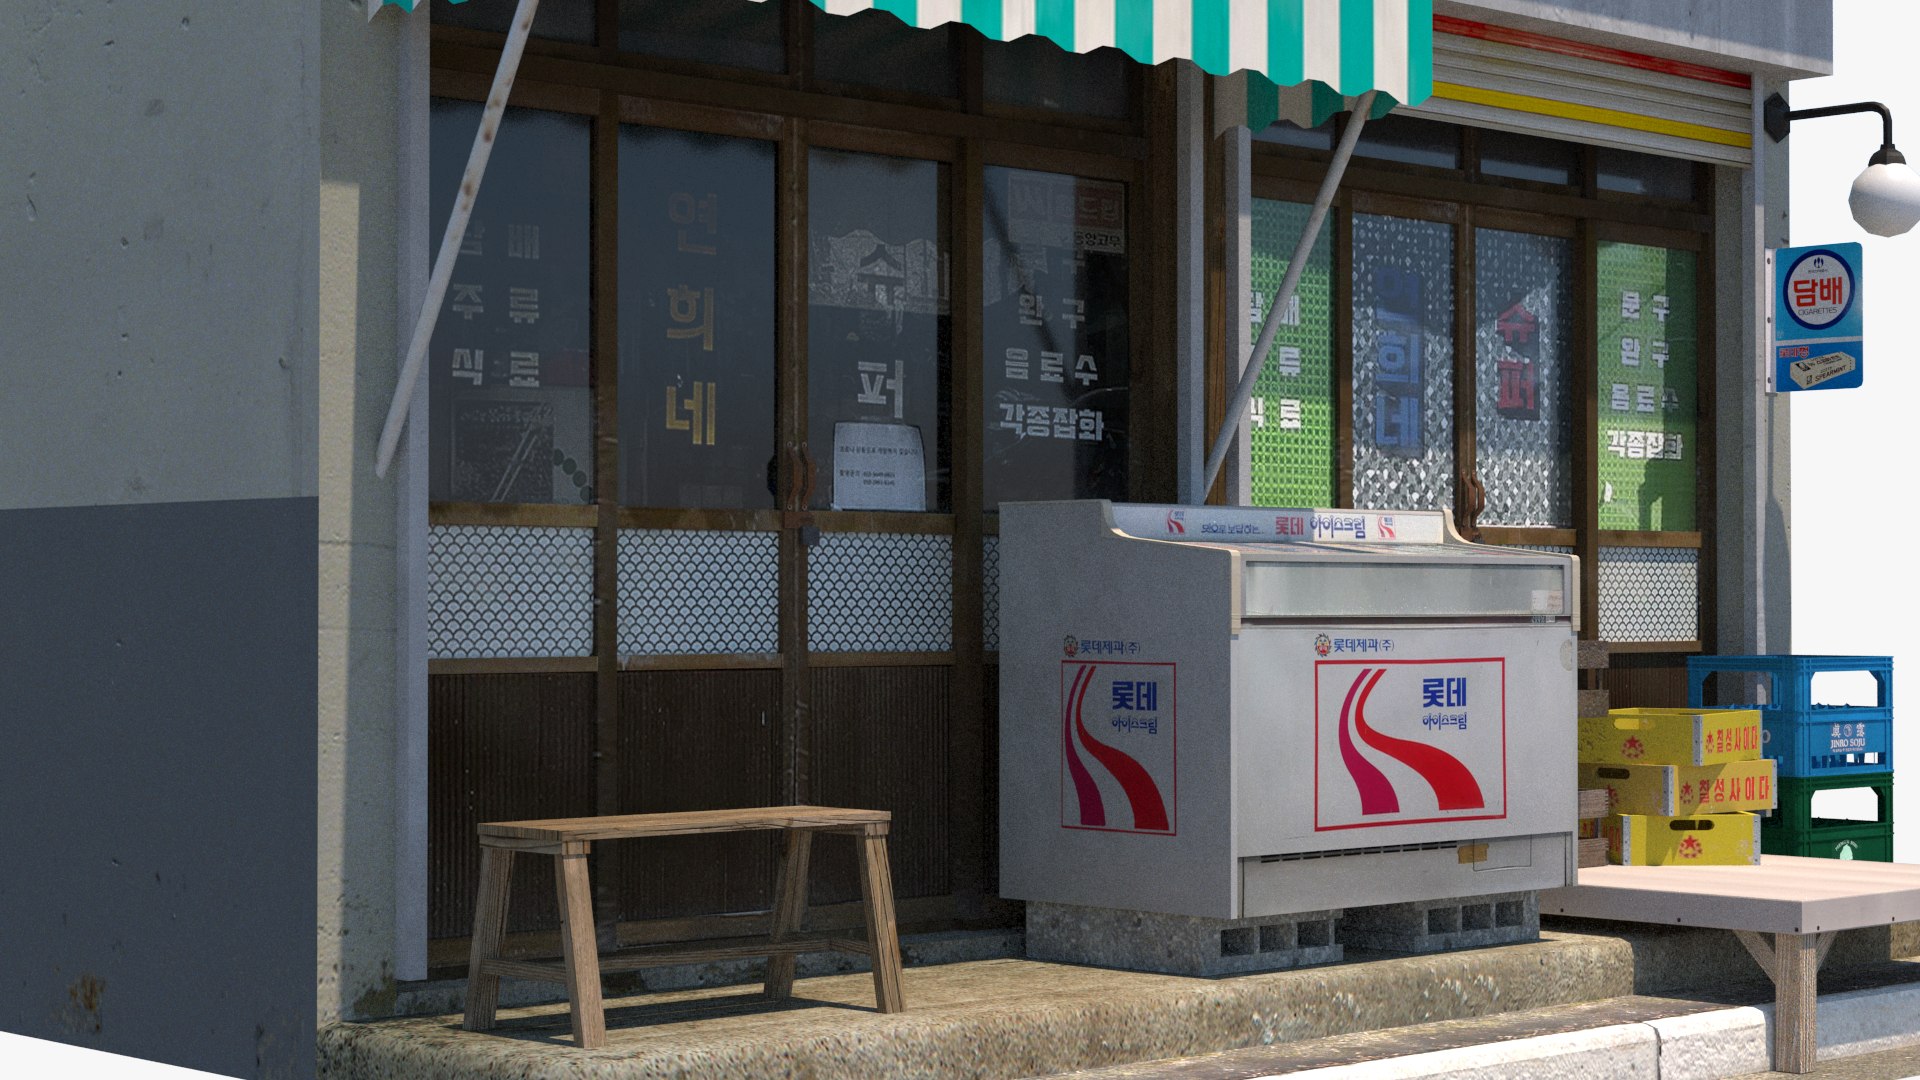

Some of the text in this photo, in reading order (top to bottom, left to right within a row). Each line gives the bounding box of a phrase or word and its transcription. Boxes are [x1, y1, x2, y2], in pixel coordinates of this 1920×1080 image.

[452, 283, 540, 324] 주류
[1793, 276, 1843, 307] 담배
[1797, 306, 1838, 316] CIGARETTES
[1005, 347, 1098, 386] 음료수
[1497, 303, 1536, 410] 슈퍼
[1815, 364, 1847, 383] SPEARMINT
[999, 403, 1105, 442] 각종잡화
[1606, 429, 1684, 460] 각종잡화
[1275, 516, 1304, 536] 롯데
[1310, 515, 1366, 539] 아이스크림
[1080, 639, 1140, 655] 롯데제과(주)
[1333, 638, 1395, 653] 롯데제과(주)
[1112, 680, 1157, 711] 롯데
[1422, 677, 1467, 708] 롯데
[1112, 716, 1158, 735] 아이스크림
[1422, 712, 1468, 731] 아이스크림
[1717, 725, 1758, 753] 칠성사이다
[1830, 737, 1866, 749] JINRO SOJU
[1699, 775, 1770, 804] 칠성사이다
